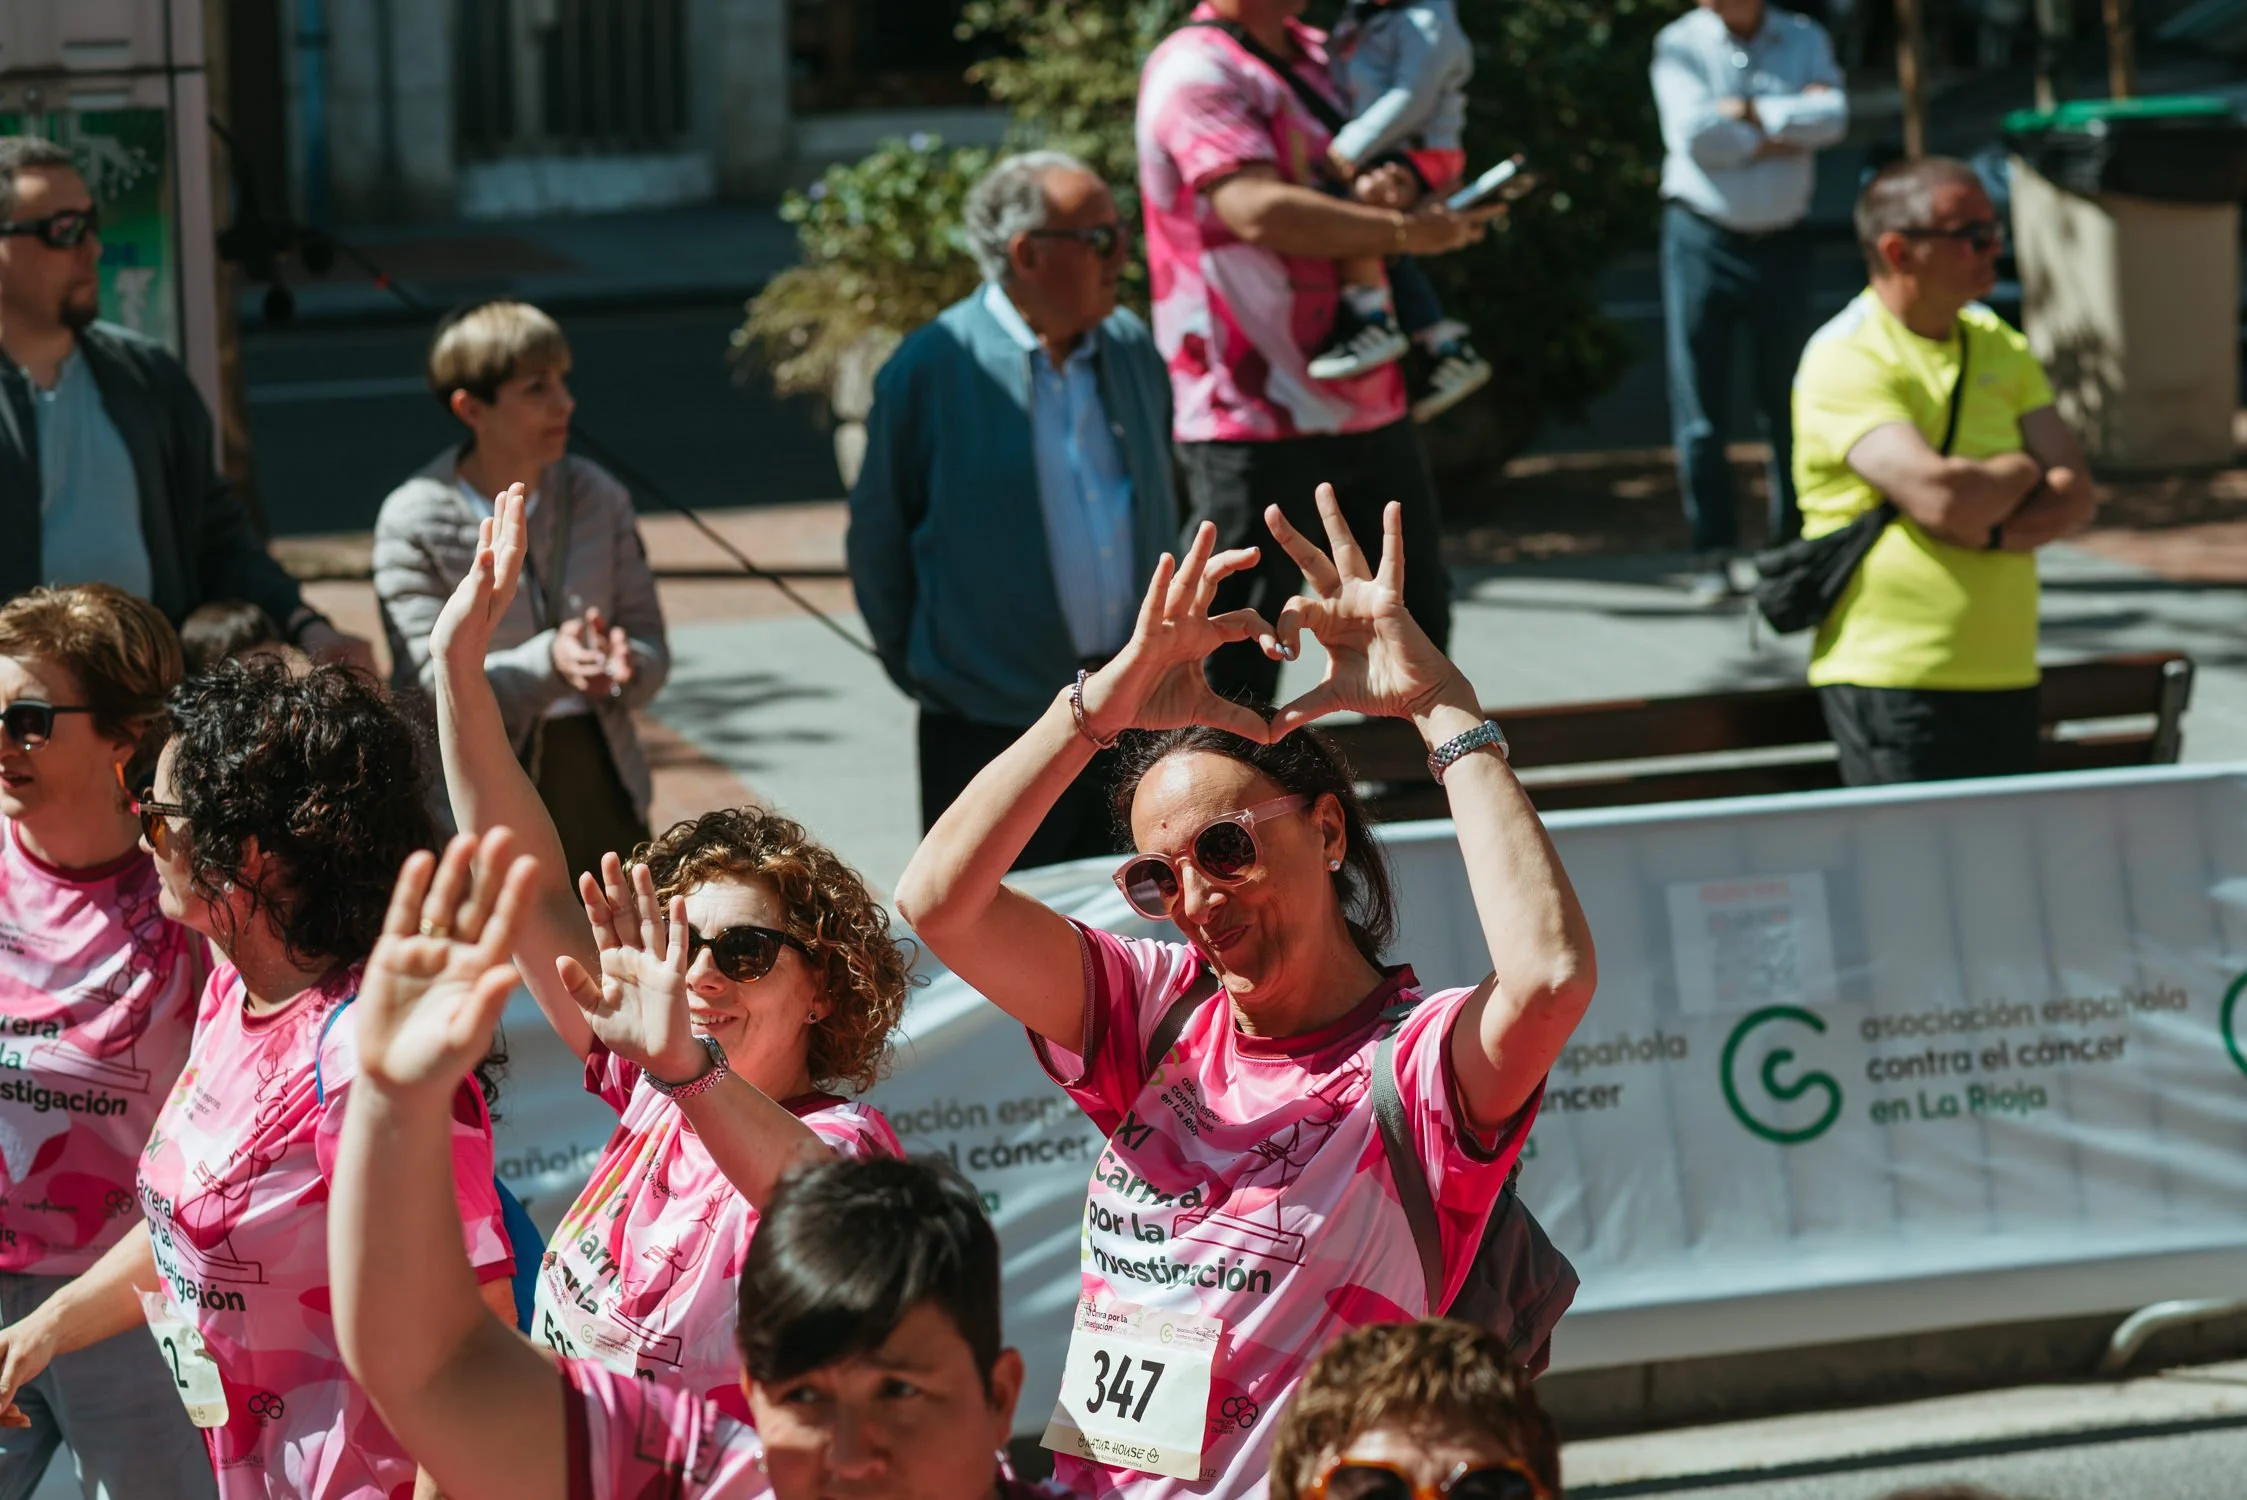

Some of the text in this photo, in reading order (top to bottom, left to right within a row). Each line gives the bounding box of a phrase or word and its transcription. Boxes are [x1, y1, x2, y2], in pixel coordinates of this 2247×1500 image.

[1860, 983, 2188, 1042] asociación española
[1557, 1027, 1689, 1077] spañola
[1866, 1031, 2126, 1083] contra el cáncer
[0, 1077, 128, 1116] stigación
[1869, 1077, 2048, 1126] en La Rioja
[968, 1131, 1092, 1172] cáncer
[1115, 1111, 1155, 1151] XI
[1090, 1198, 1165, 1245] por la
[1086, 1350, 1166, 1423] 347
[1112, 1442, 1146, 1459] HOUSE
